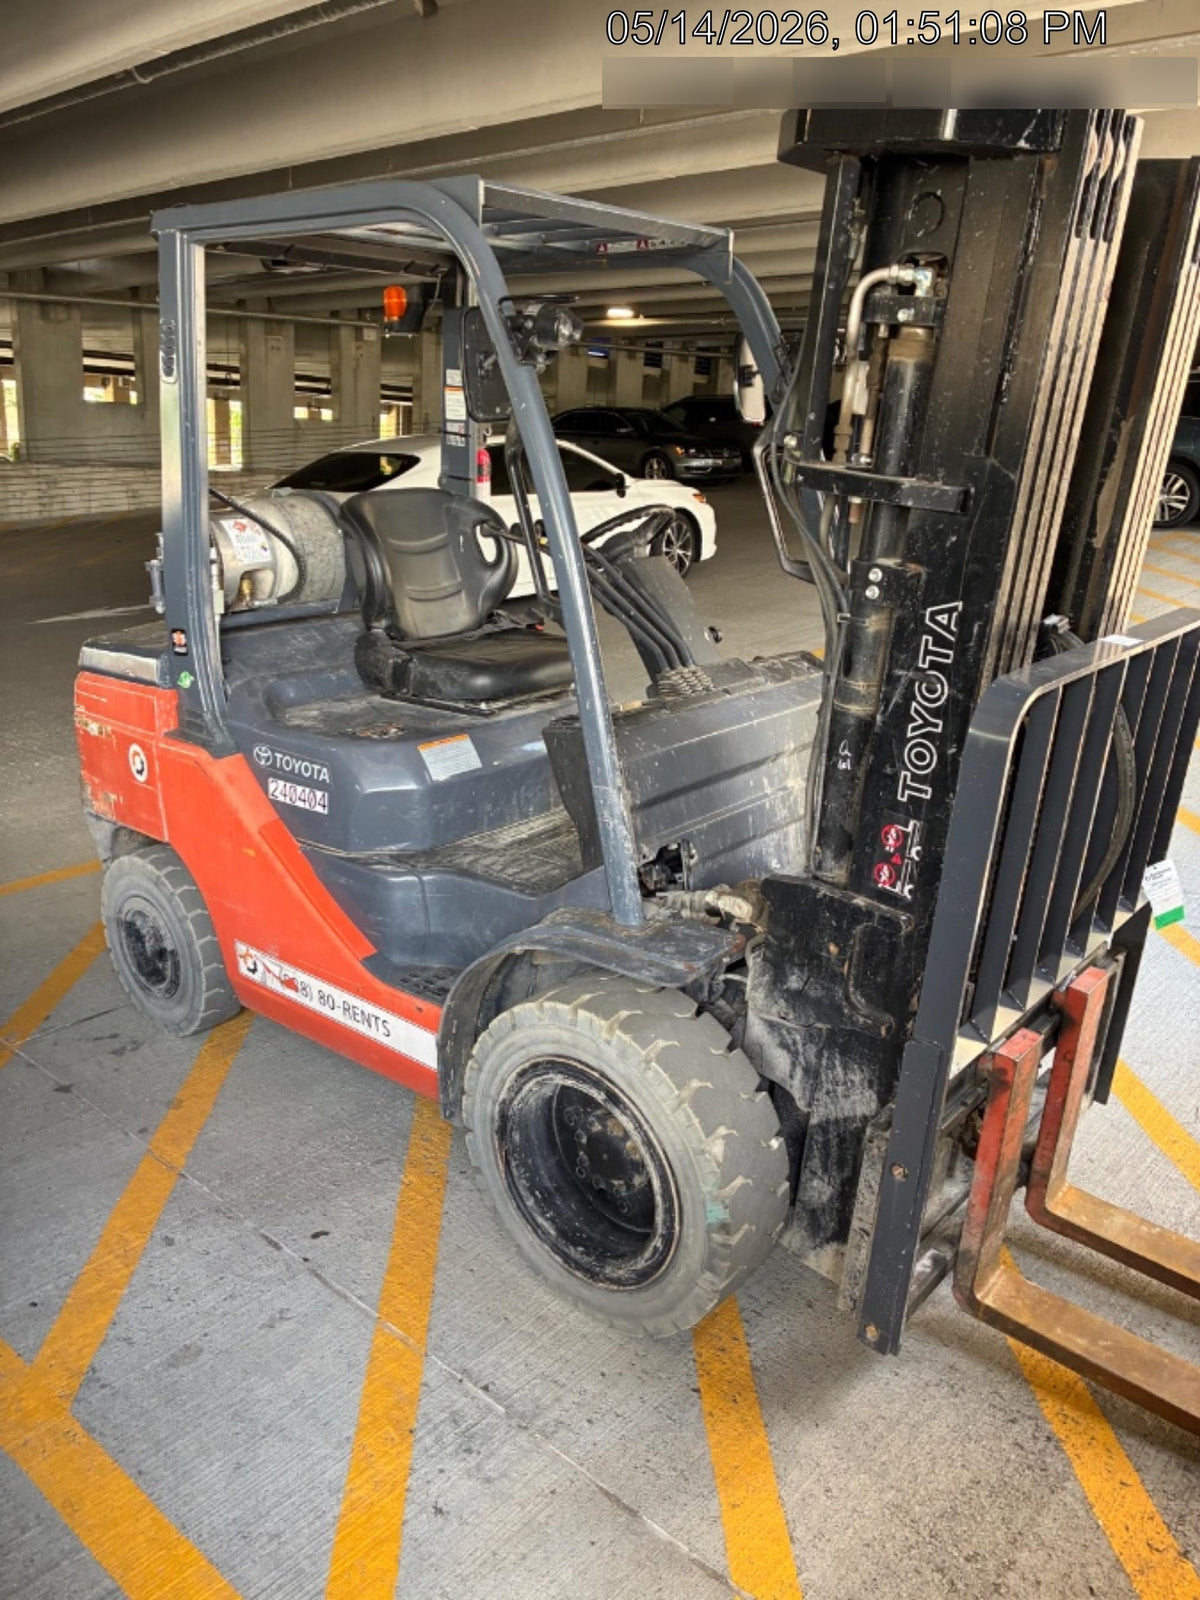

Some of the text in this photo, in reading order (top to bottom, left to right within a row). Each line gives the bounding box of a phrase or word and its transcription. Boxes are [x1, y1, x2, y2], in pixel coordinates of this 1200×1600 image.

[897, 601, 963, 802] TOYOTA
[274, 752, 330, 784] TOYOTA
[269, 778, 327, 812] 240404
[317, 989, 391, 1038] 80-RENTS
